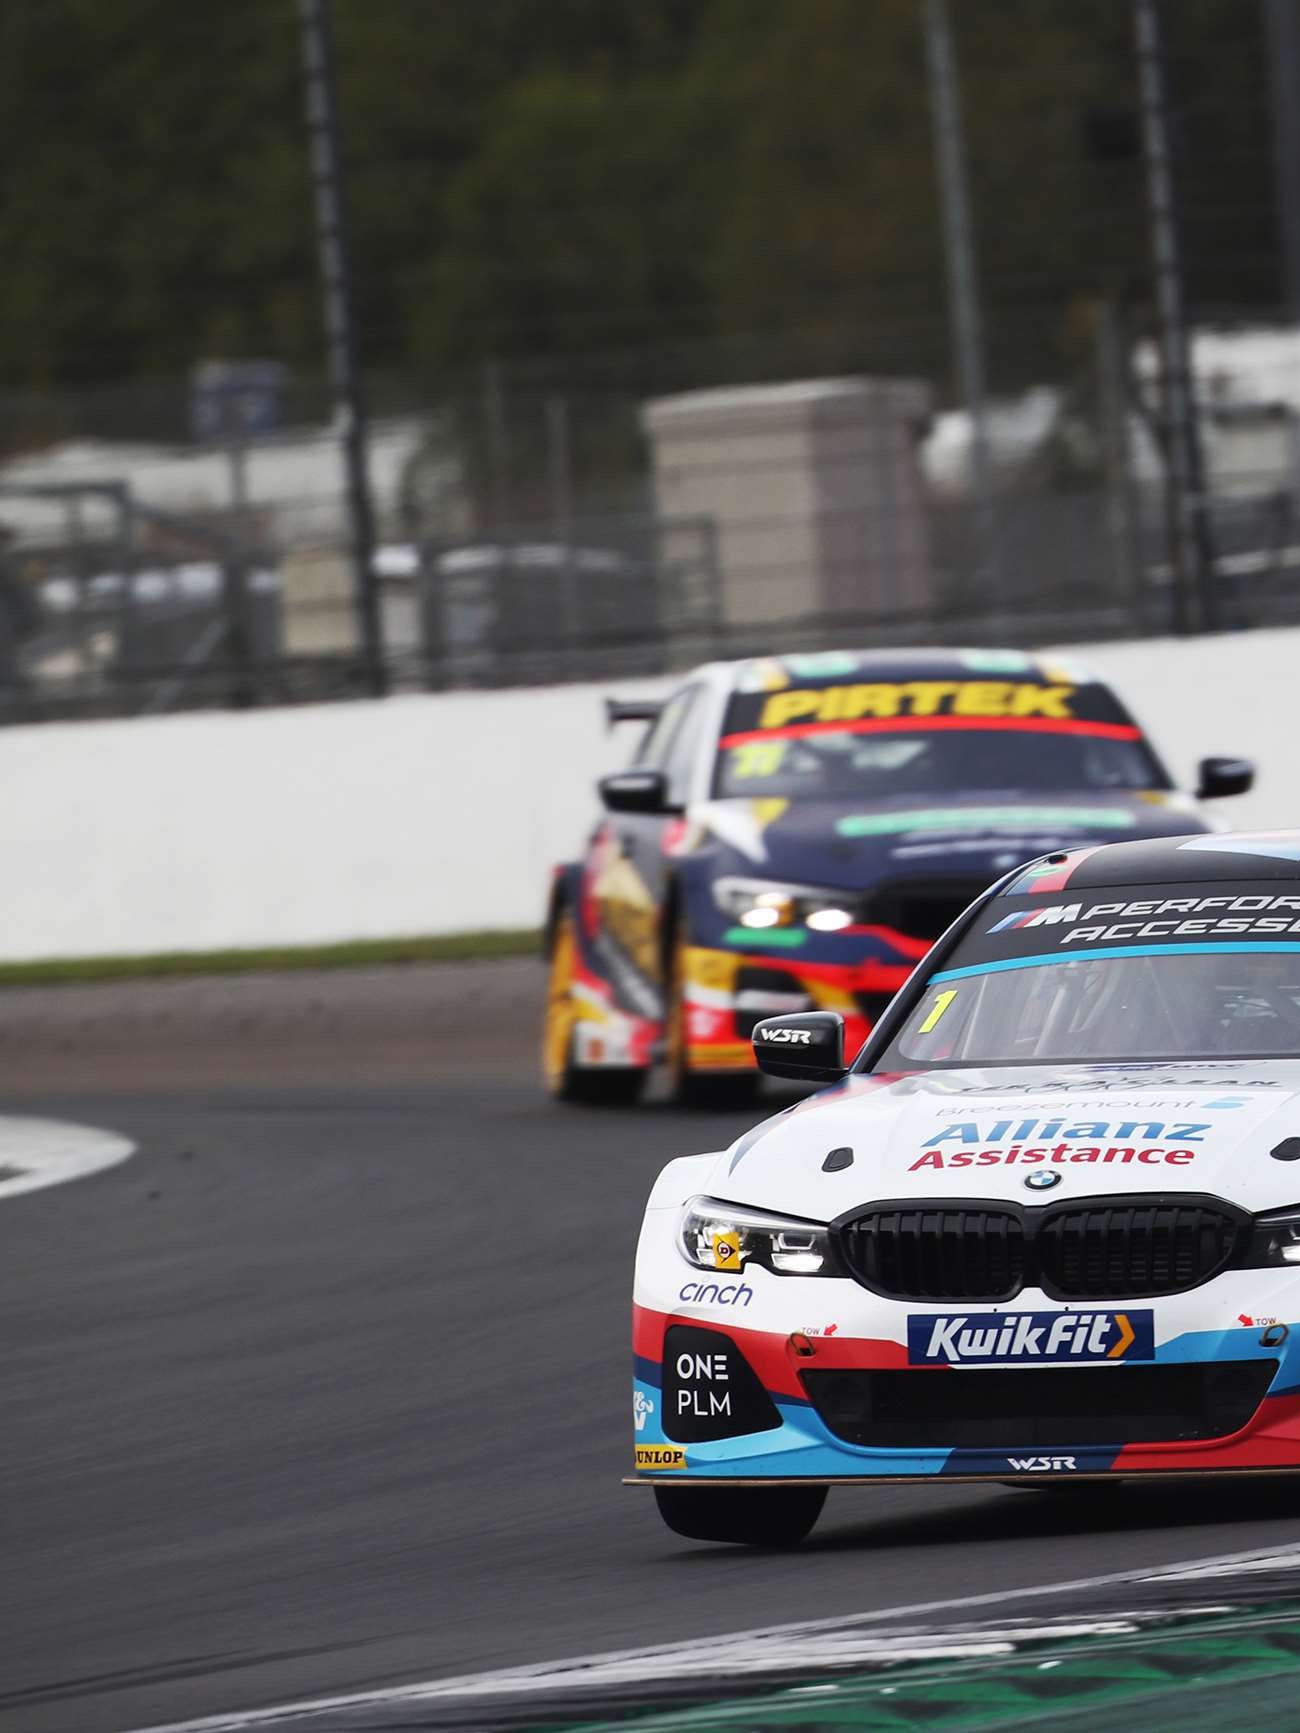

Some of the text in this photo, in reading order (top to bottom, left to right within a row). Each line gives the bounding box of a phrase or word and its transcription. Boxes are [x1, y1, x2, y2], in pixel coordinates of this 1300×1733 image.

[759, 681, 1076, 729] PIRTEK
[918, 990, 958, 1035] 1
[760, 1028, 812, 1045] WSR
[920, 1117, 1213, 1147] Allianz
[907, 1143, 1195, 1172] Assistance
[679, 1282, 753, 1306] cinch
[676, 1354, 729, 1380] ONE
[678, 1389, 731, 1416] PLM
[636, 1450, 683, 1464] UNLOP
[1006, 1456, 1077, 1472] WSR
